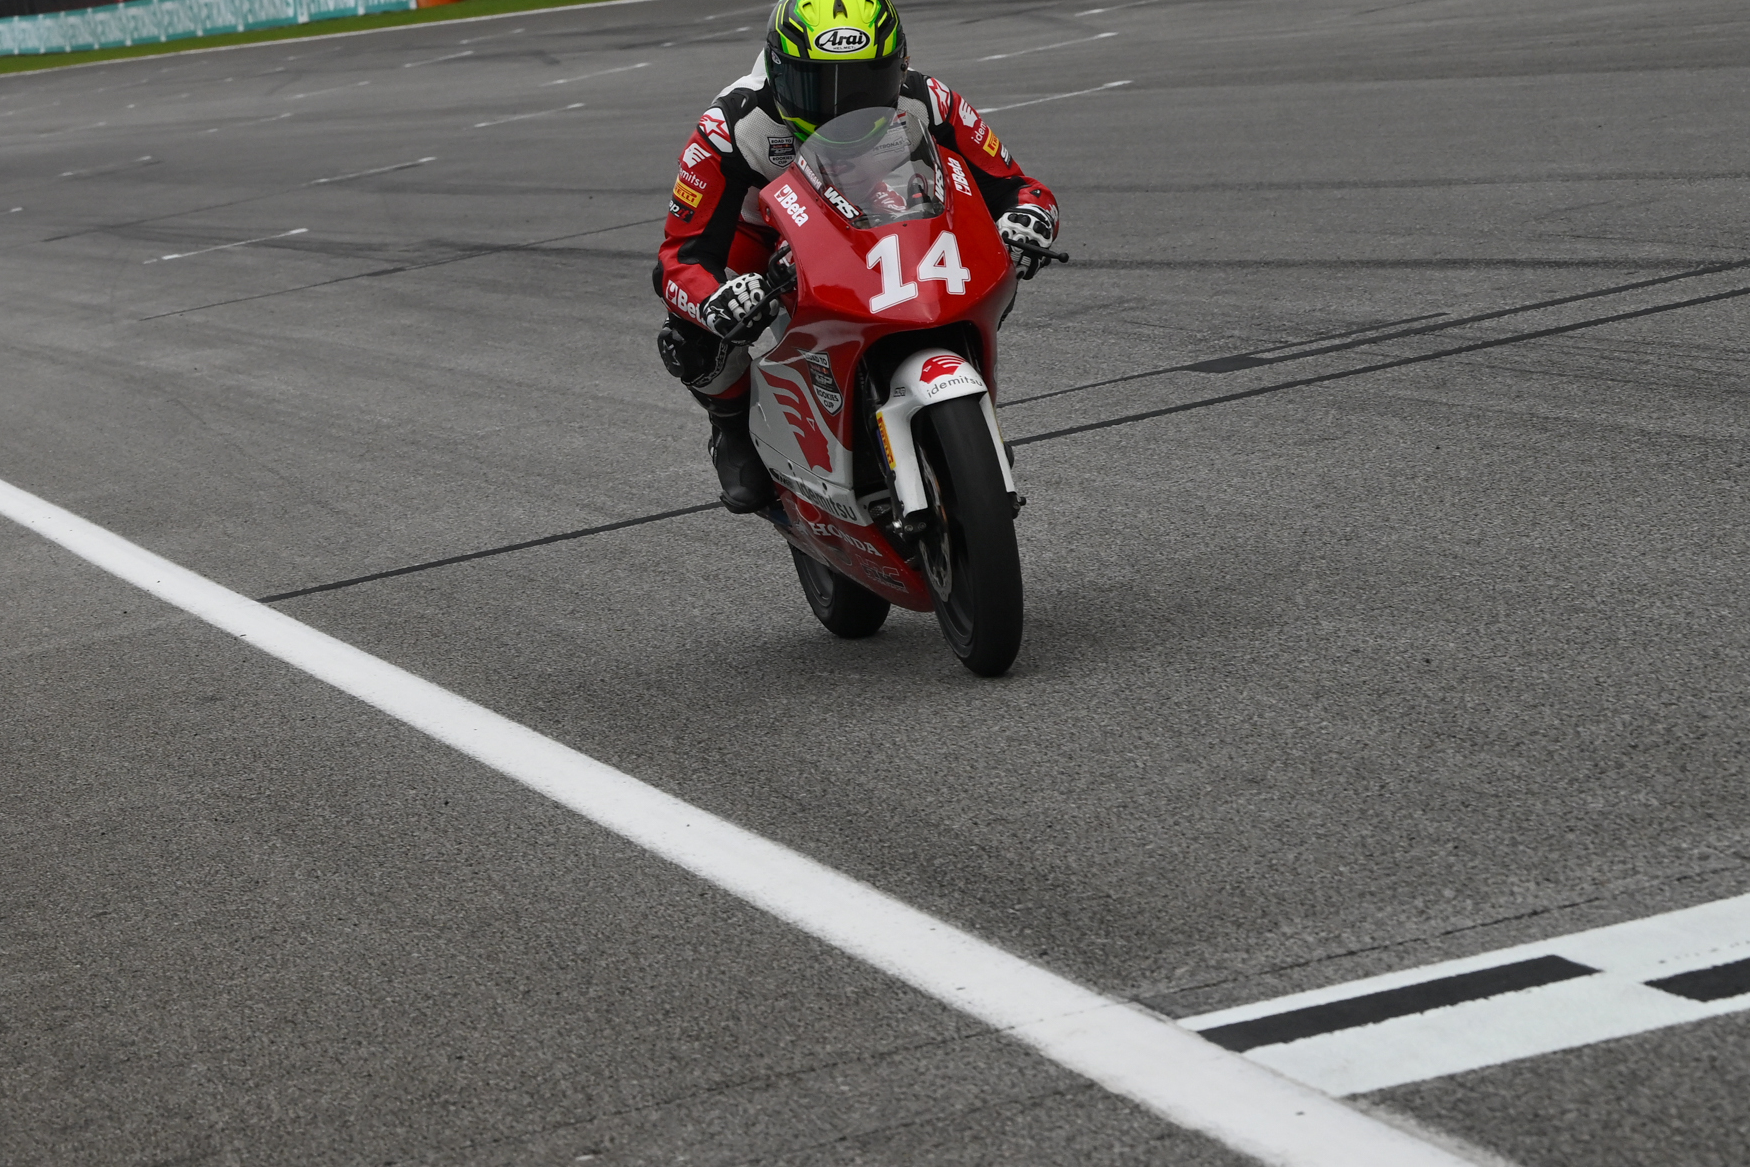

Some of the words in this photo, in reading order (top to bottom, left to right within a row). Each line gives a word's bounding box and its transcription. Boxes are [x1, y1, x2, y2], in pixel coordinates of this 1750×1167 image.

[818, 30, 864, 48] Arai
[679, 167, 707, 190] emitsu
[947, 156, 969, 192] Beta
[674, 180, 698, 203] RELLI
[782, 189, 809, 227] Beta
[823, 186, 860, 220] WRS
[866, 229, 972, 315] 14
[926, 375, 984, 399] idemitsu
[796, 477, 858, 522] idemitsu
[810, 522, 883, 557] HONDA
